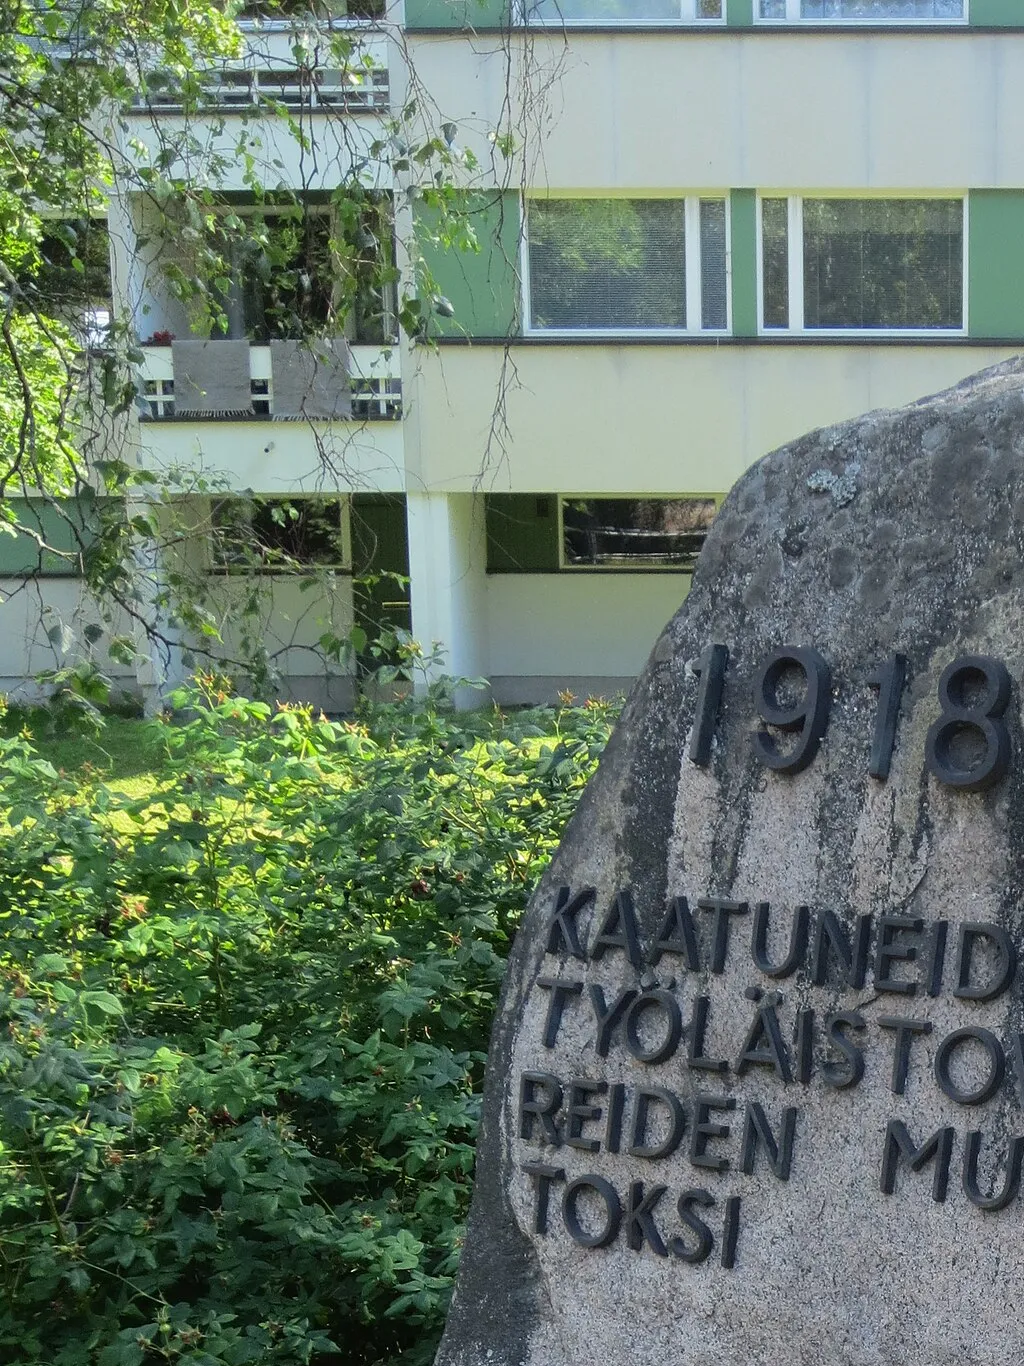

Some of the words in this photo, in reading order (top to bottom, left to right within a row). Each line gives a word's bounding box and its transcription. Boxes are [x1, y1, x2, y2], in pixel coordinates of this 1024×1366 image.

[684, 643, 1012, 794] 1918
[519, 1070, 797, 1181] REIDEN
[522, 1158, 742, 1268] TOKSI
